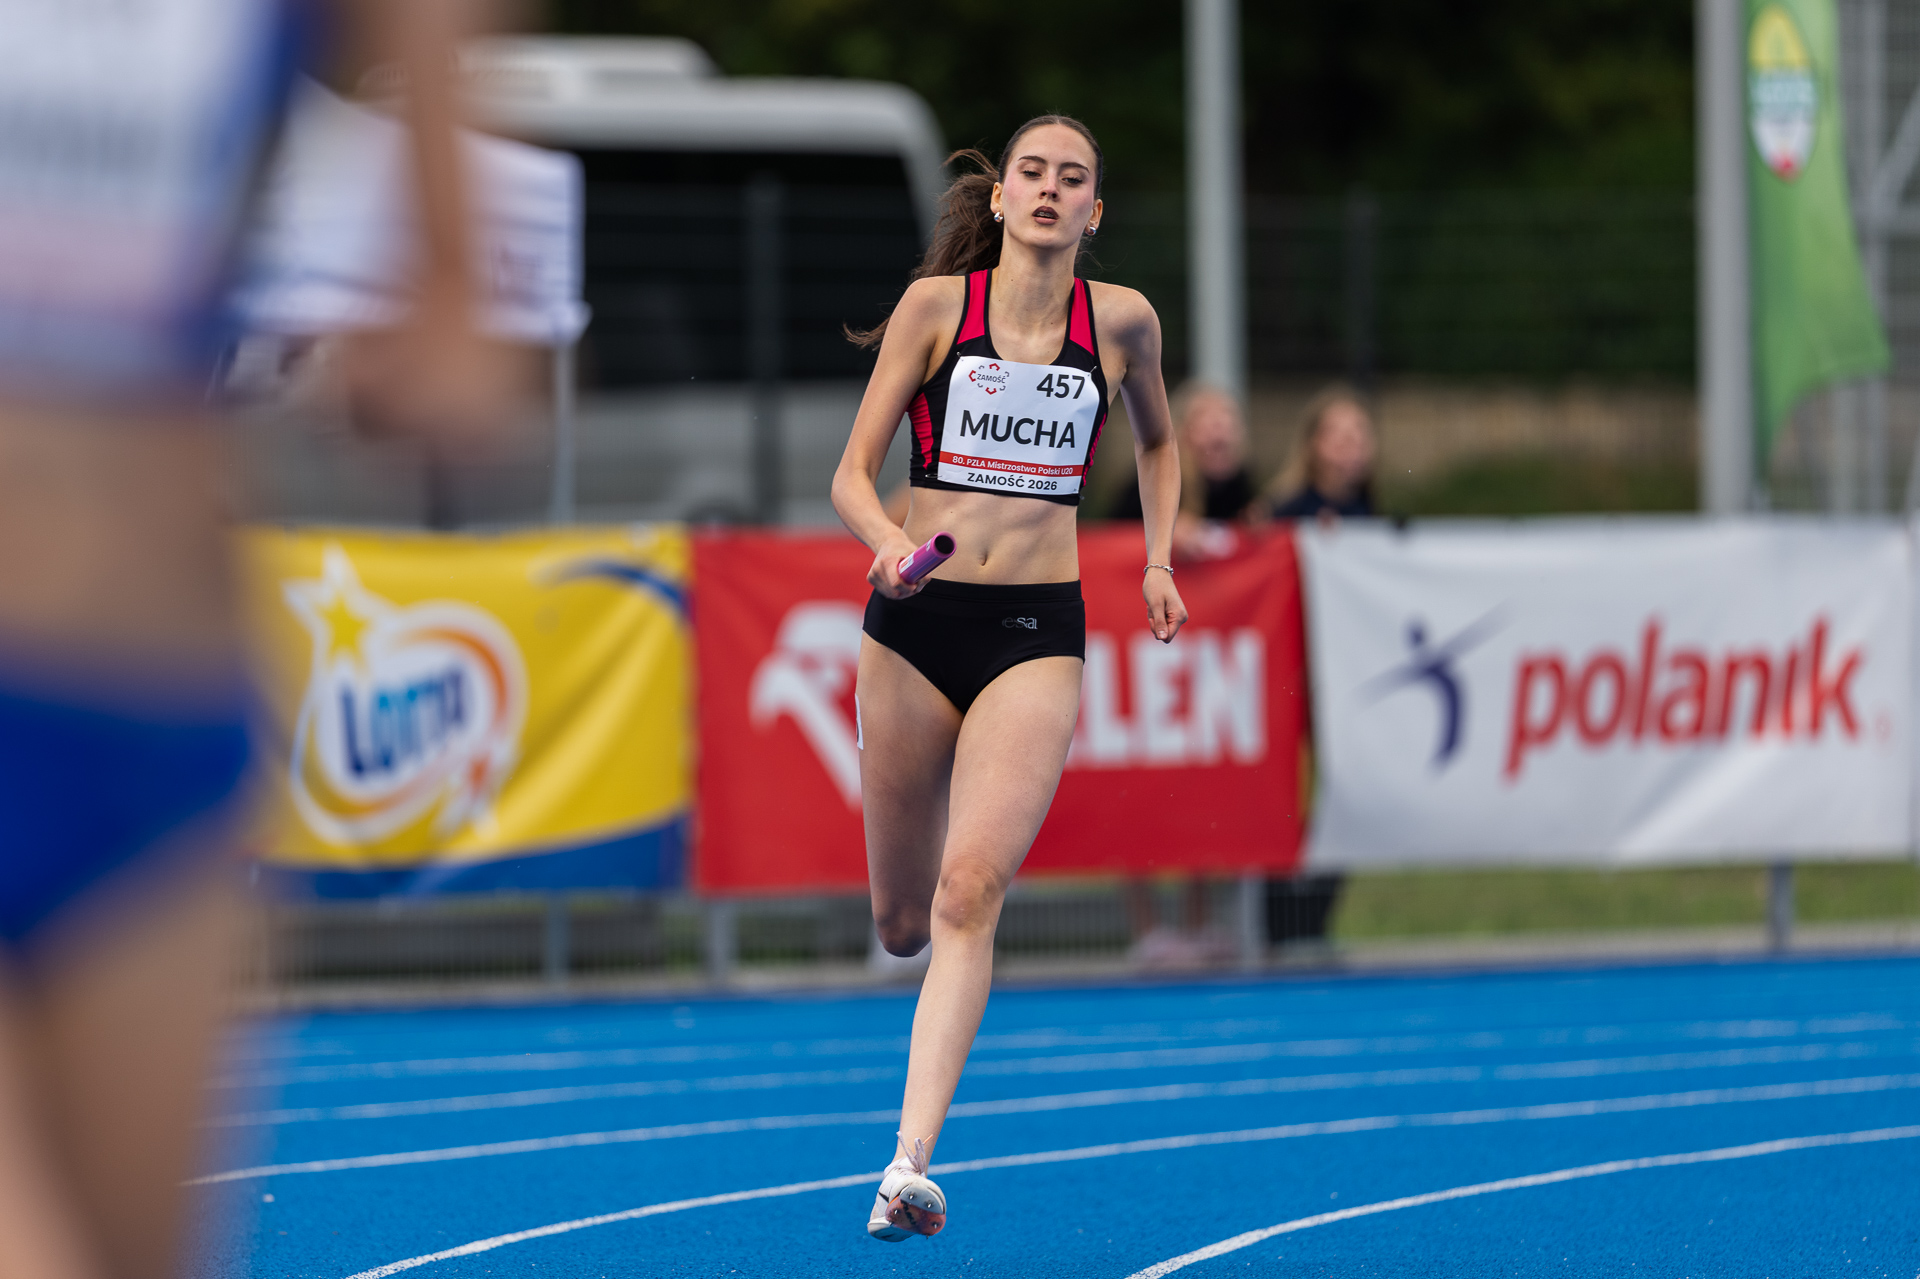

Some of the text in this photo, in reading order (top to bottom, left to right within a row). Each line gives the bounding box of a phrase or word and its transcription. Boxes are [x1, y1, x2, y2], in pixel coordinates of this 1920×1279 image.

[976, 373, 1006, 384] ZAMOŚĆ
[1036, 373, 1086, 400] 457
[959, 409, 1076, 449] MUCHA
[952, 455, 1073, 475] 80. PZLA Mistrzostwa Polski U20
[967, 472, 1058, 491] ZAMOŚĆ 2026
[1064, 630, 1265, 768] LEN
